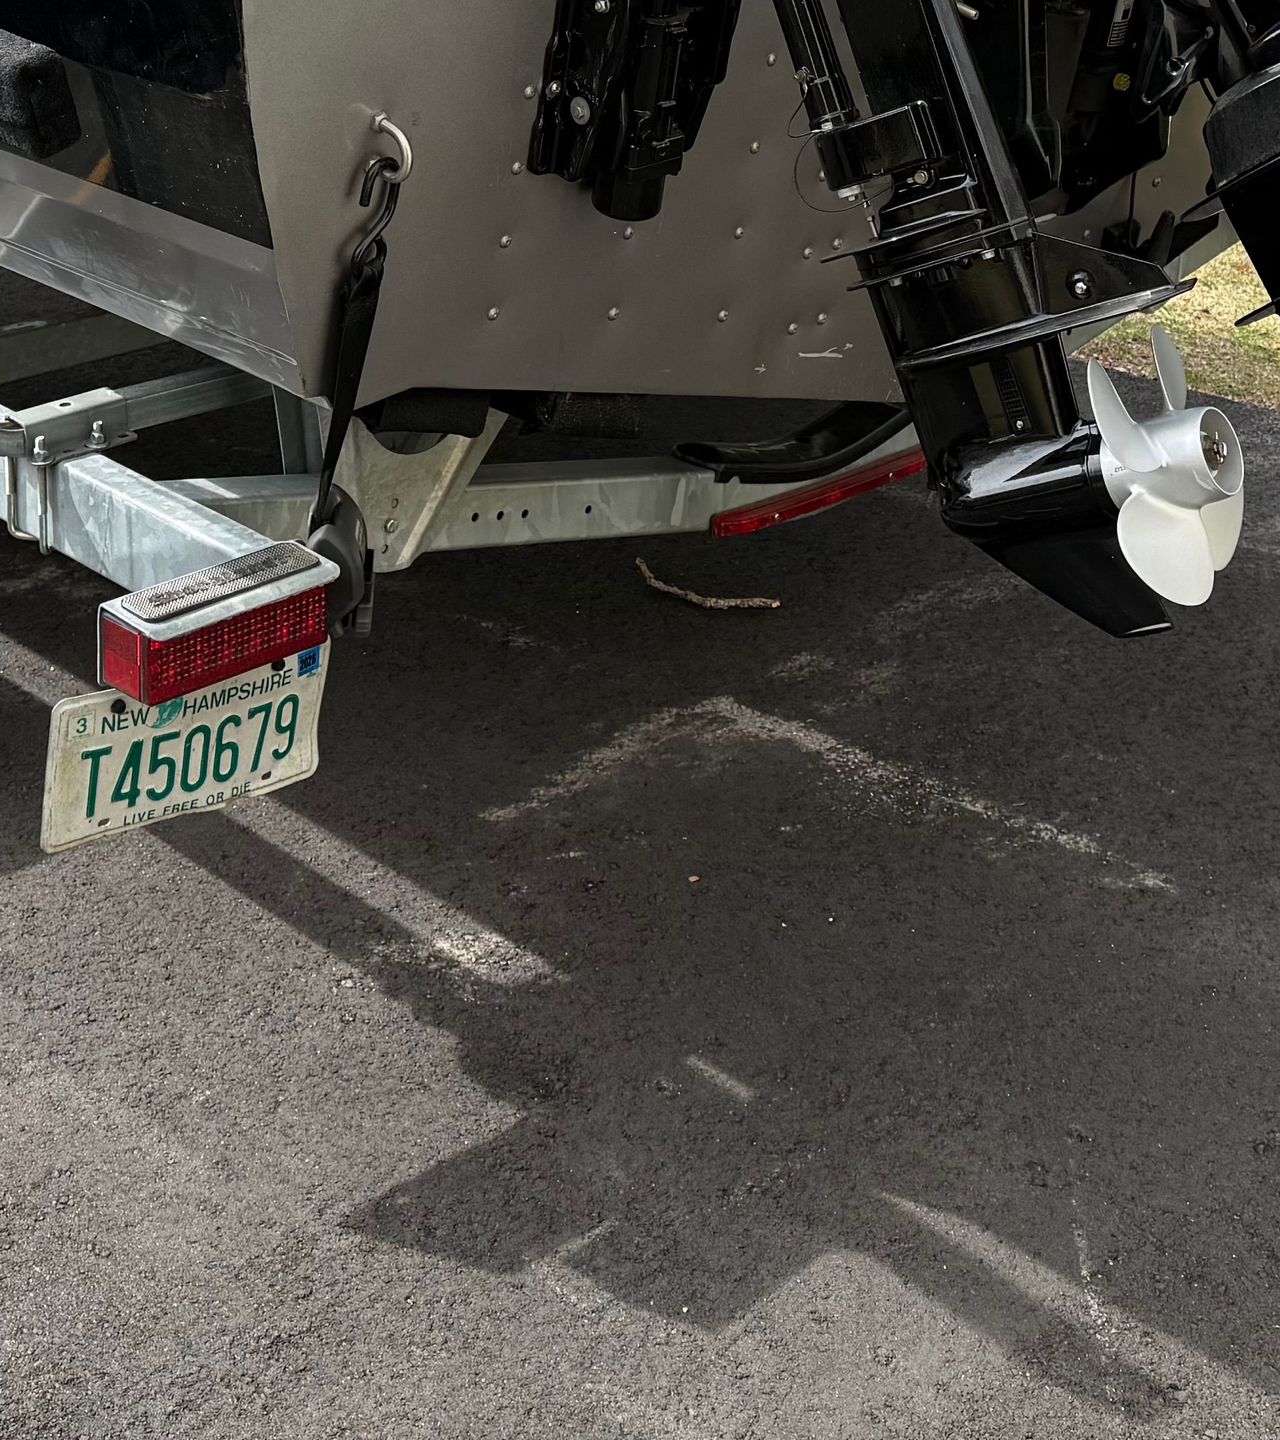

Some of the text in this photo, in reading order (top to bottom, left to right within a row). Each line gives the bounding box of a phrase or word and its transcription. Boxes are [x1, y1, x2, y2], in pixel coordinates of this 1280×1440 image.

[76, 717, 88, 734] 3
[101, 668, 294, 735] NEW HAMPSHIRE
[81, 692, 300, 818] T450679
[123, 781, 252, 826] LIVE FREE OR DIE
